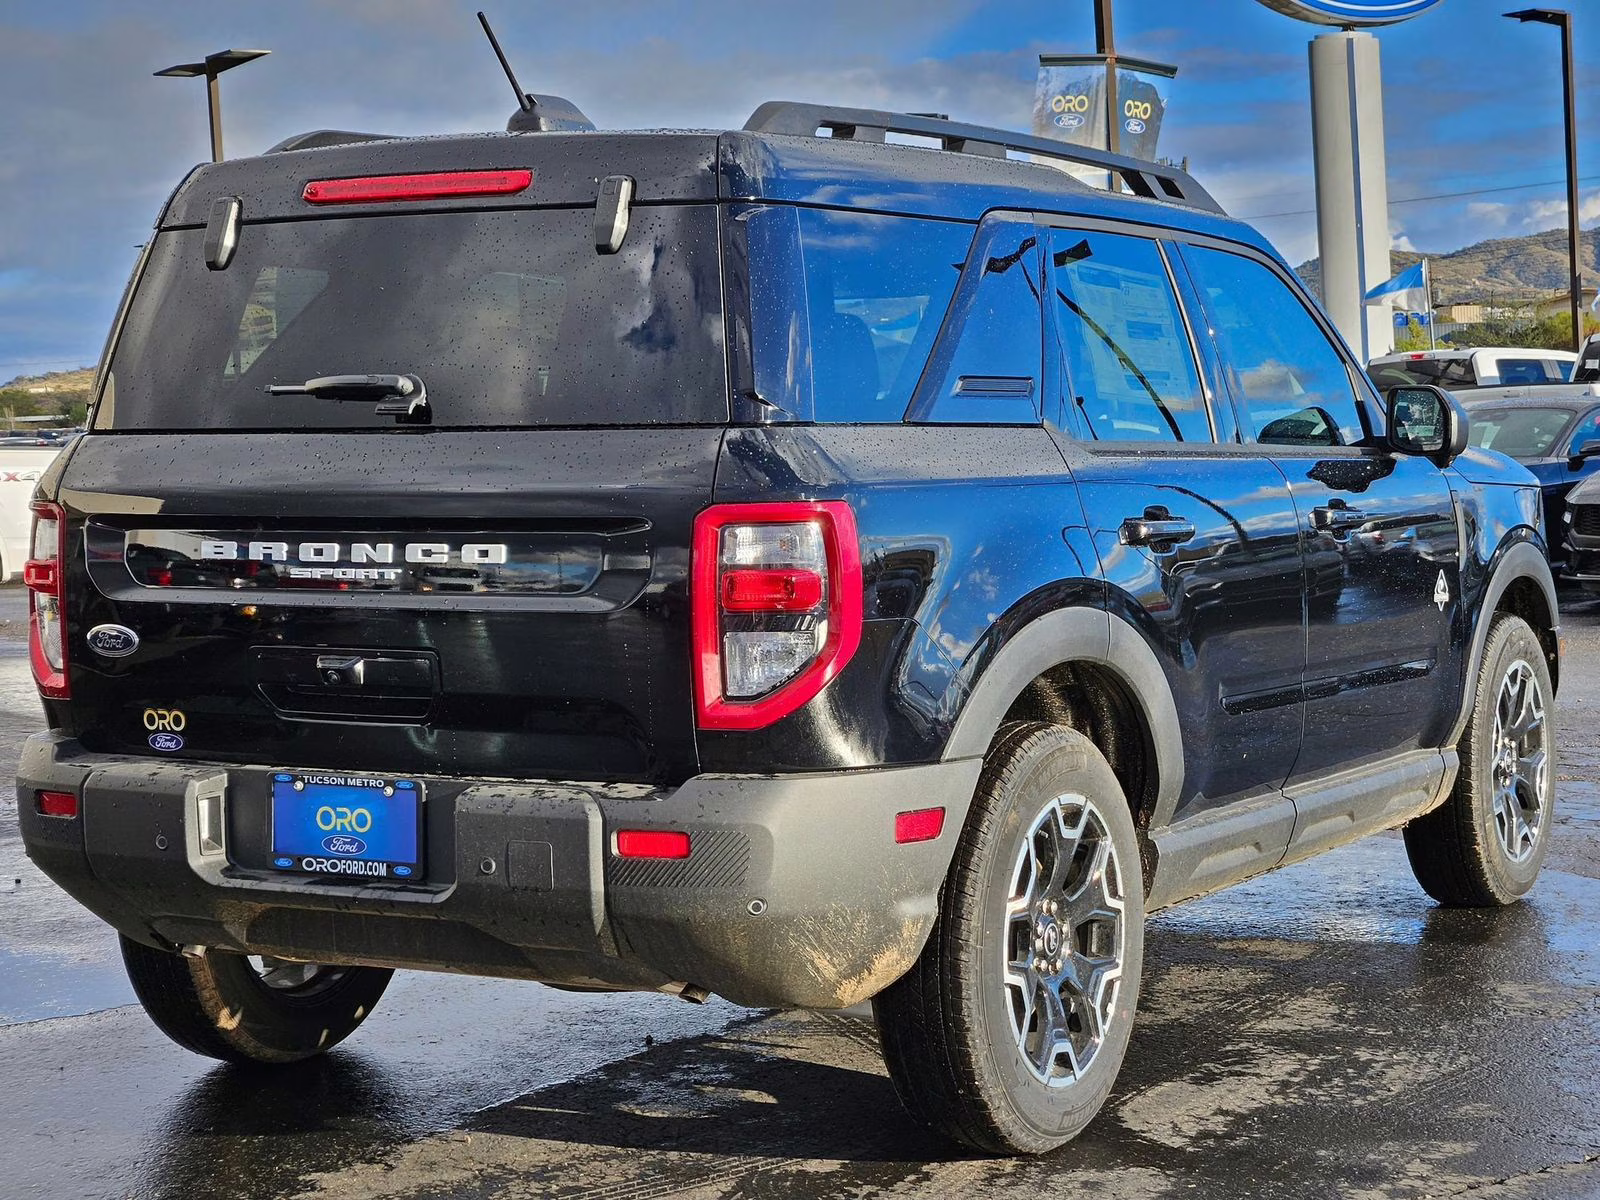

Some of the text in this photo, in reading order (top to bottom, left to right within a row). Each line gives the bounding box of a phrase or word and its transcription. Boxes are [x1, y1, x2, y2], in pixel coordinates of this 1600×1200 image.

[1052, 95, 1089, 113] ORO
[1124, 99, 1151, 120] ORO
[201, 541, 507, 564] BRONCO
[289, 567, 402, 580] SPORT
[96, 630, 128, 648] Ford
[143, 709, 186, 732] ORO
[155, 735, 177, 749] Ford
[303, 775, 345, 786] TUCSON
[347, 778, 385, 788] METRO
[316, 806, 372, 833] ORO
[330, 837, 359, 853] Ford
